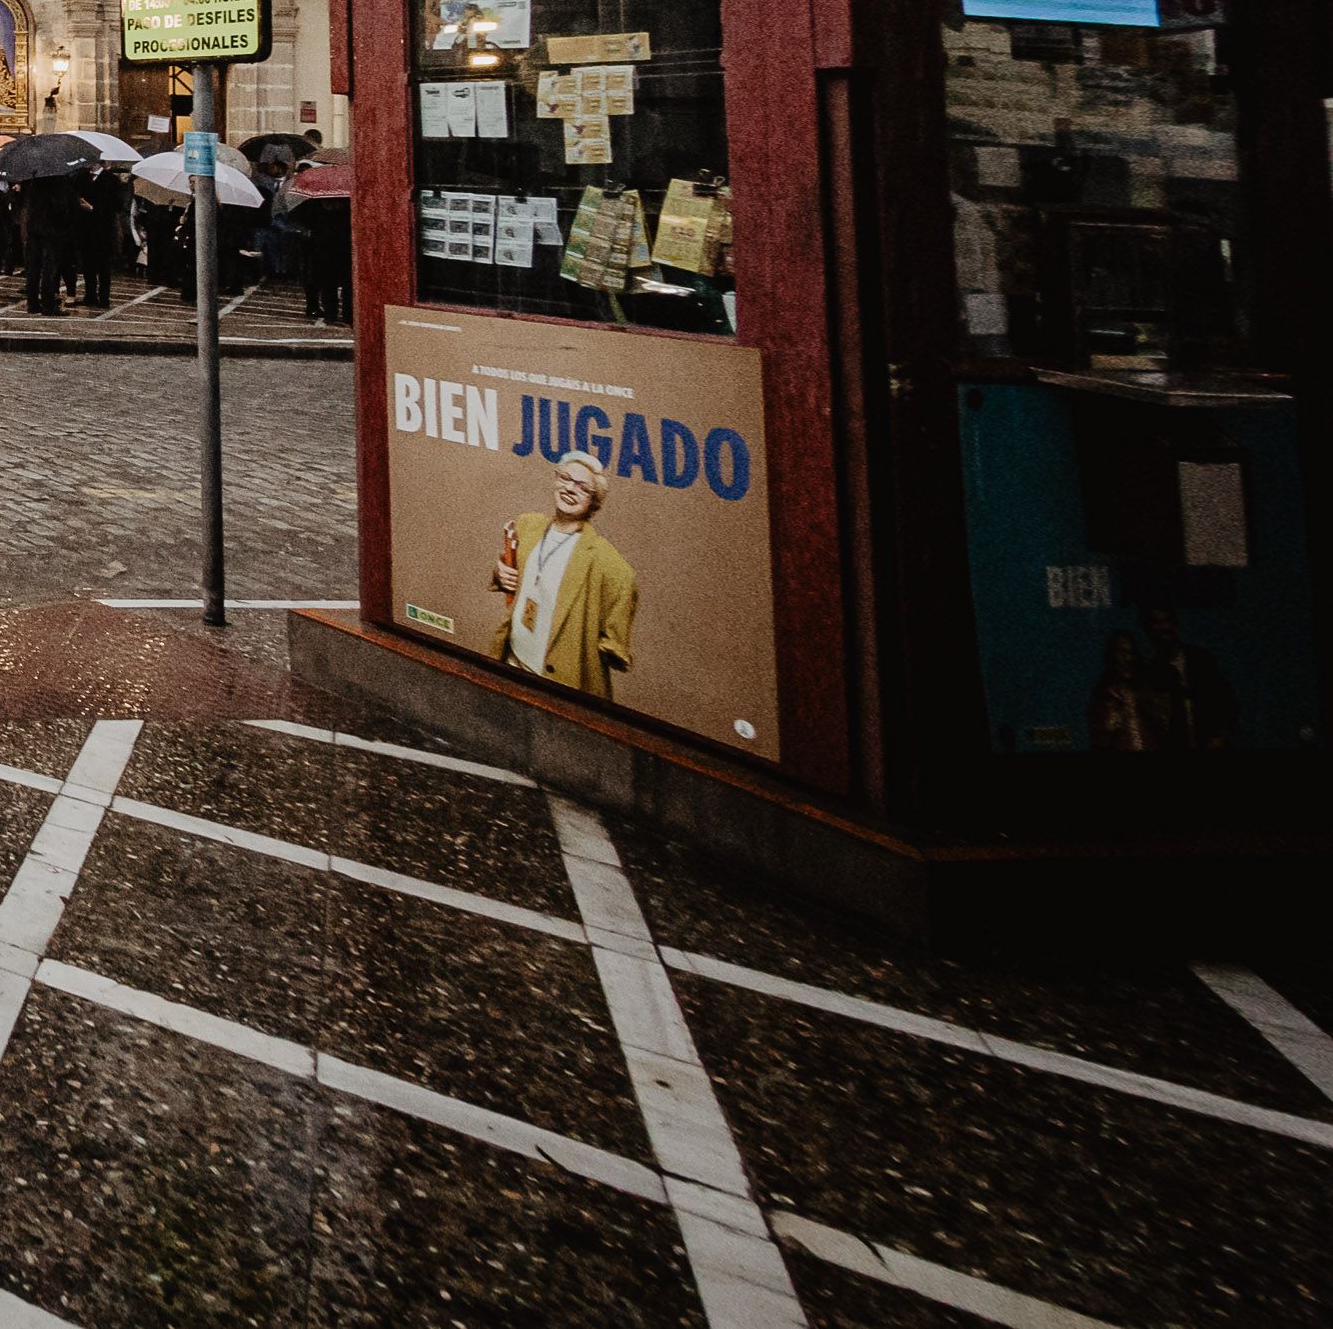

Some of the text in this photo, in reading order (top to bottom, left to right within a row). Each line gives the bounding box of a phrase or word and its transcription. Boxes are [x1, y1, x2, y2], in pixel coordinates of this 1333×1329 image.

[129, 0, 142, 11] DE
[127, 8, 255, 31] PASO DE DESFILES
[133, 34, 249, 54] PROCESIONALES
[591, 382, 605, 394] LA
[605, 384, 635, 399] ONCE
[393, 372, 751, 502] BIEN JUGADO
[1046, 564, 1112, 609] BIEN
[419, 610, 451, 631] ONCE
